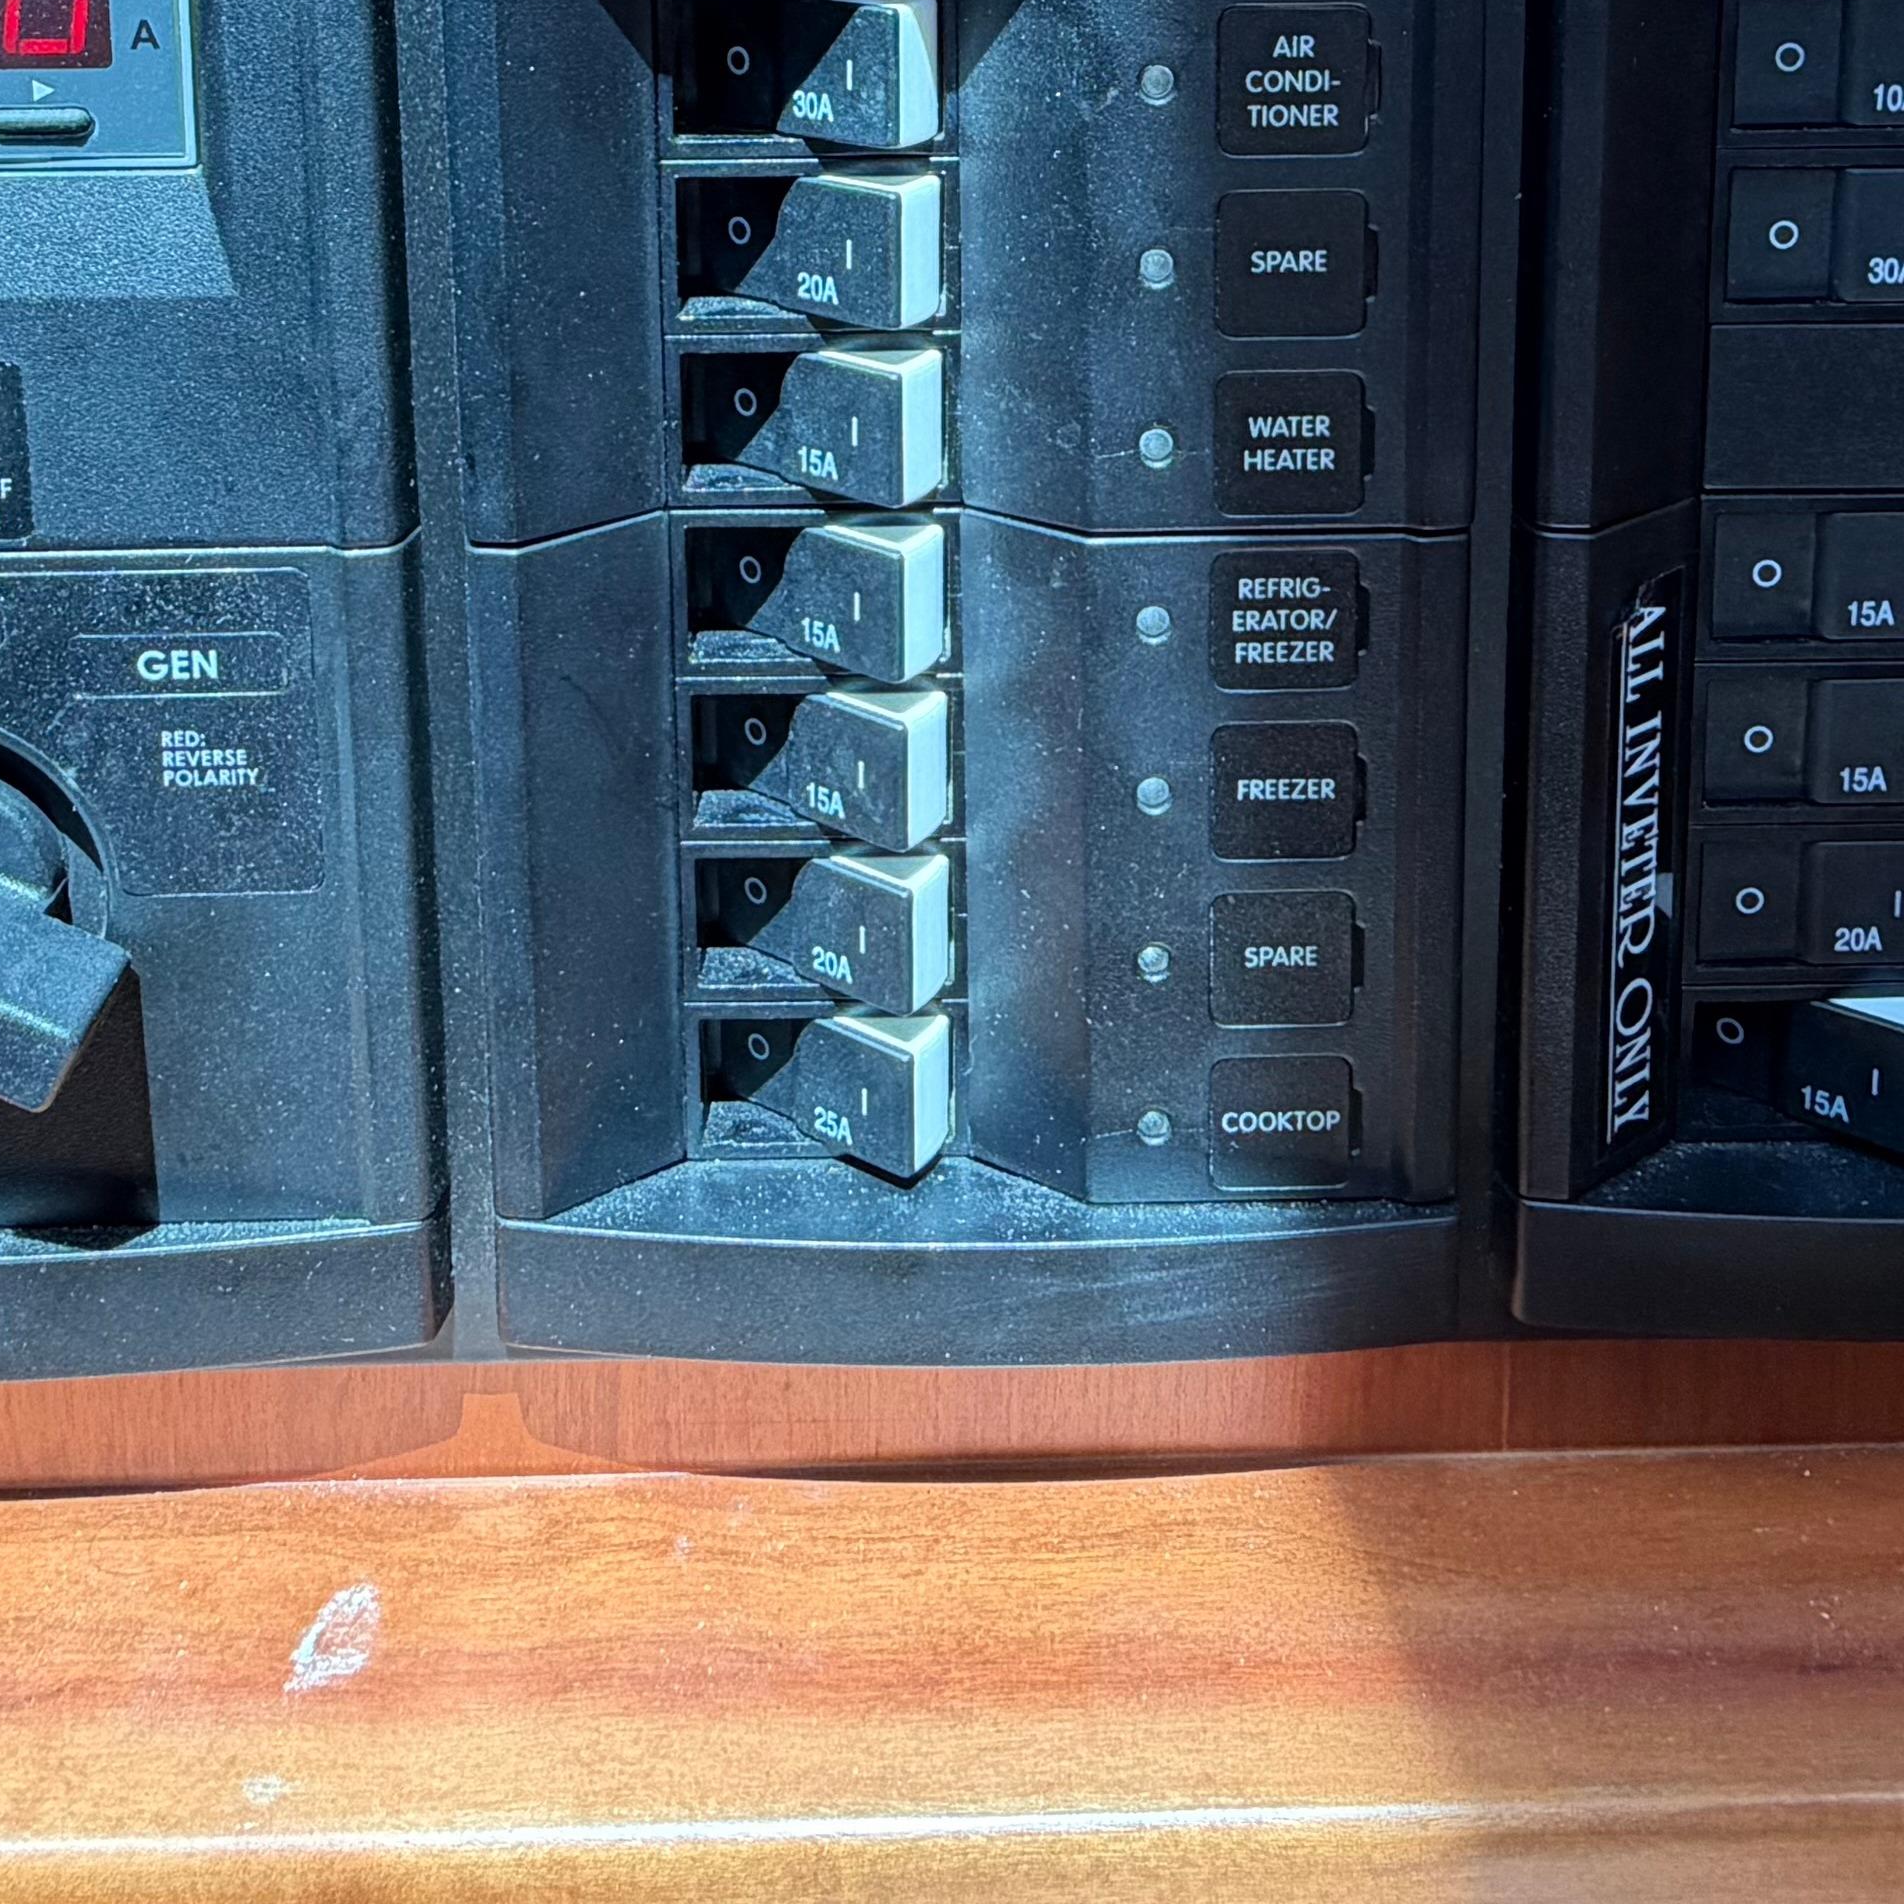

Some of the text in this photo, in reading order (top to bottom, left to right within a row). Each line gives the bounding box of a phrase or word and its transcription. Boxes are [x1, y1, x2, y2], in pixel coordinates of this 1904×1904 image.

[130, 19, 161, 51] A
[1272, 35, 1315, 58] AIR
[1245, 69, 1342, 94] CONDI-
[792, 89, 835, 122] 30A
[1247, 103, 1339, 128] TIONER
[1250, 249, 1328, 274] SPARE
[796, 271, 840, 306] 20A
[1247, 415, 1331, 439] WATER
[798, 446, 840, 481] 15A
[1243, 448, 1336, 472] HEATER
[1238, 576, 1331, 601] REFRIG-
[1231, 607, 1338, 633] ERATOR/
[1847, 599, 1895, 628] 15A
[800, 617, 841, 654] 15A
[136, 649, 220, 681] GEN
[1234, 640, 1335, 665] FREEZER
[1625, 604, 1667, 704] ALL
[161, 730, 206, 748] RED:
[162, 749, 248, 768] REVERSE
[163, 768, 260, 788] POLARITY
[1236, 778, 1336, 802] FREEZER
[1839, 765, 1888, 793] 15A
[805, 781, 845, 819] 15A
[1833, 925, 1883, 952] 20A
[811, 945, 853, 985] 20A
[1244, 945, 1318, 969] SPARE
[1613, 977, 1655, 1135] ONLY
[1800, 1085, 1850, 1124] 15A
[813, 1106, 854, 1146] 25A
[1221, 1110, 1341, 1134] COOKTOP
